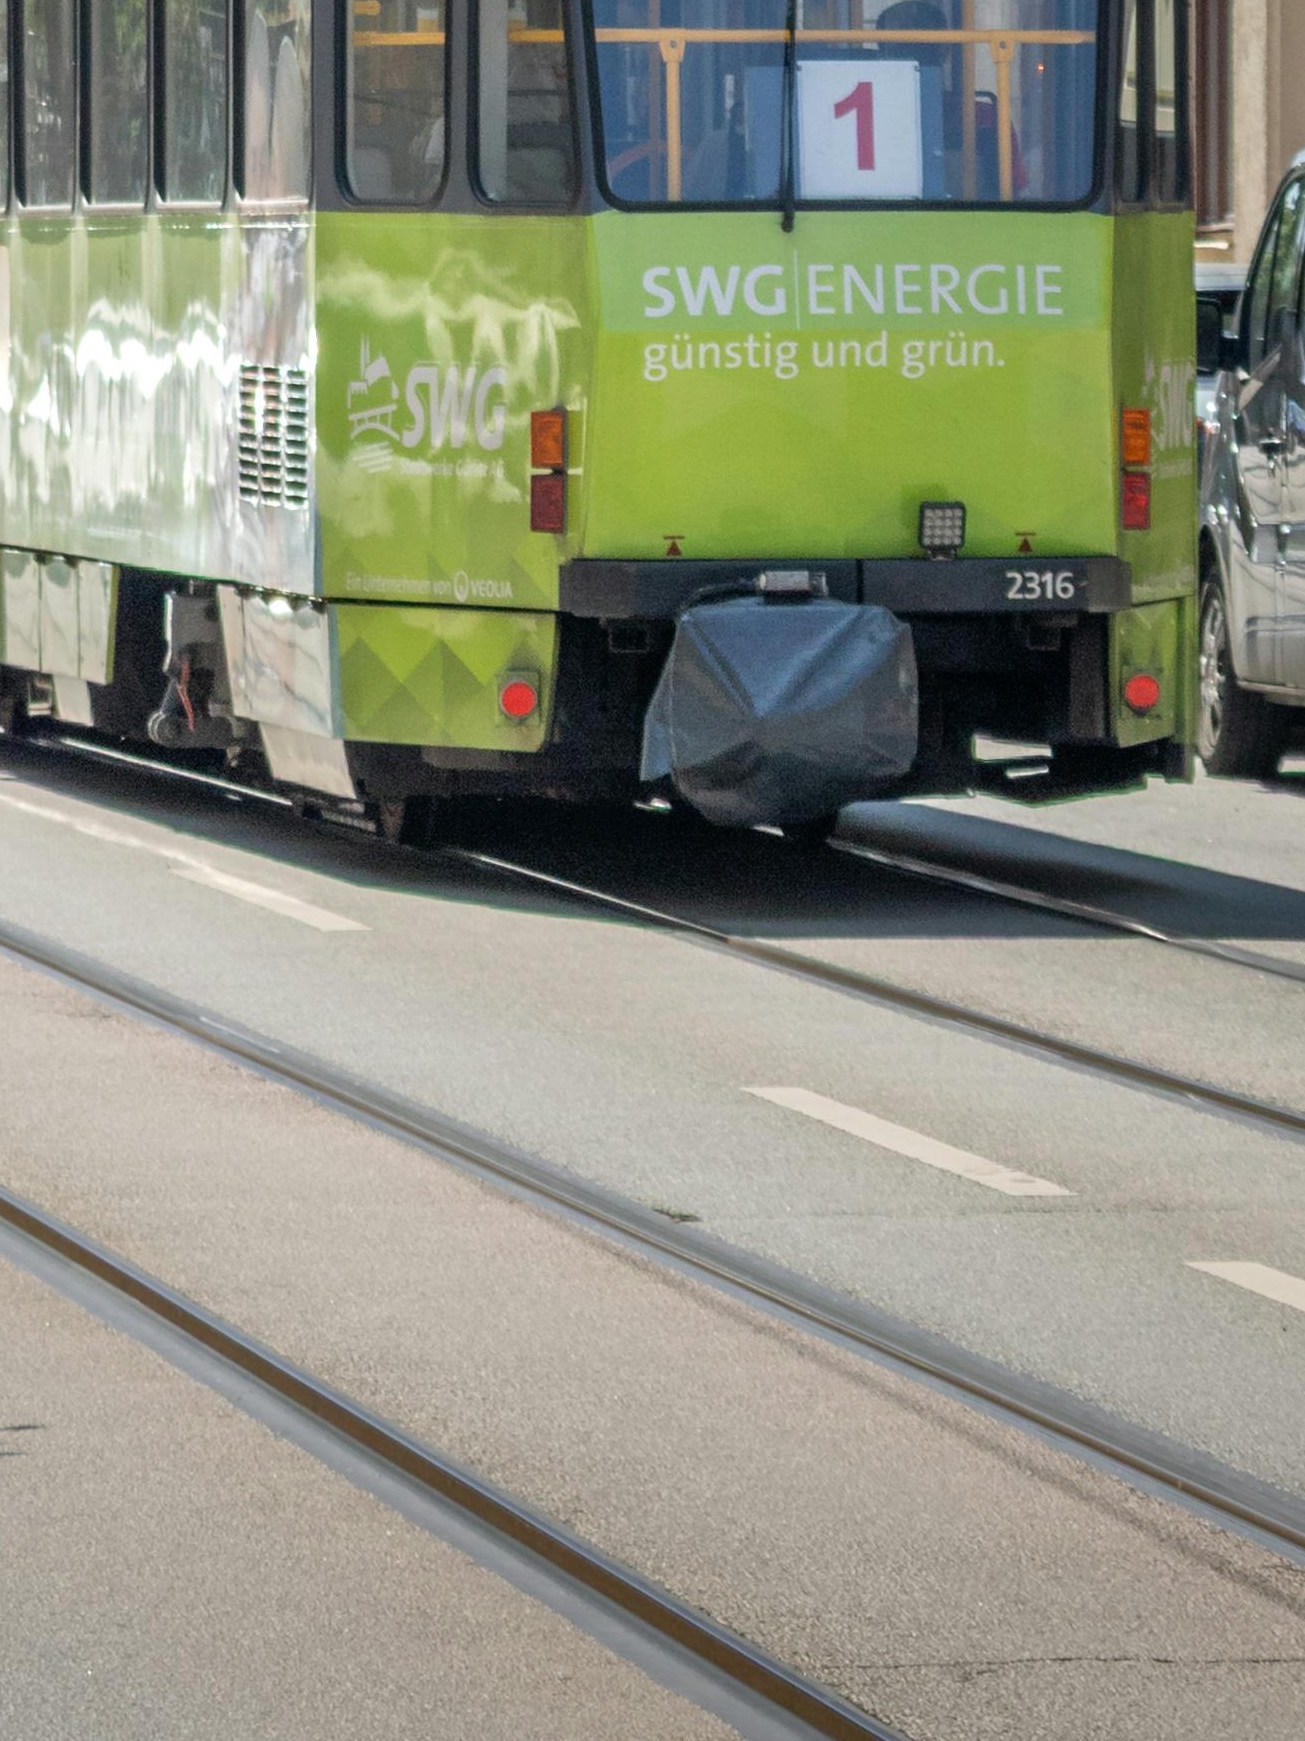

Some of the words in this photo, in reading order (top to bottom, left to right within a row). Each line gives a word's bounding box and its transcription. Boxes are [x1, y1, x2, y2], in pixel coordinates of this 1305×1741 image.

[832, 81, 876, 172] 1
[642, 264, 787, 318] SWG
[807, 264, 1064, 316] ENERGIE
[643, 332, 799, 382] günstig
[811, 331, 888, 368] und
[901, 331, 1006, 379] grün.
[400, 362, 508, 451] SWG
[433, 579, 452, 596] von
[471, 579, 514, 599] VEOLIA
[1006, 571, 1075, 600] 2316
